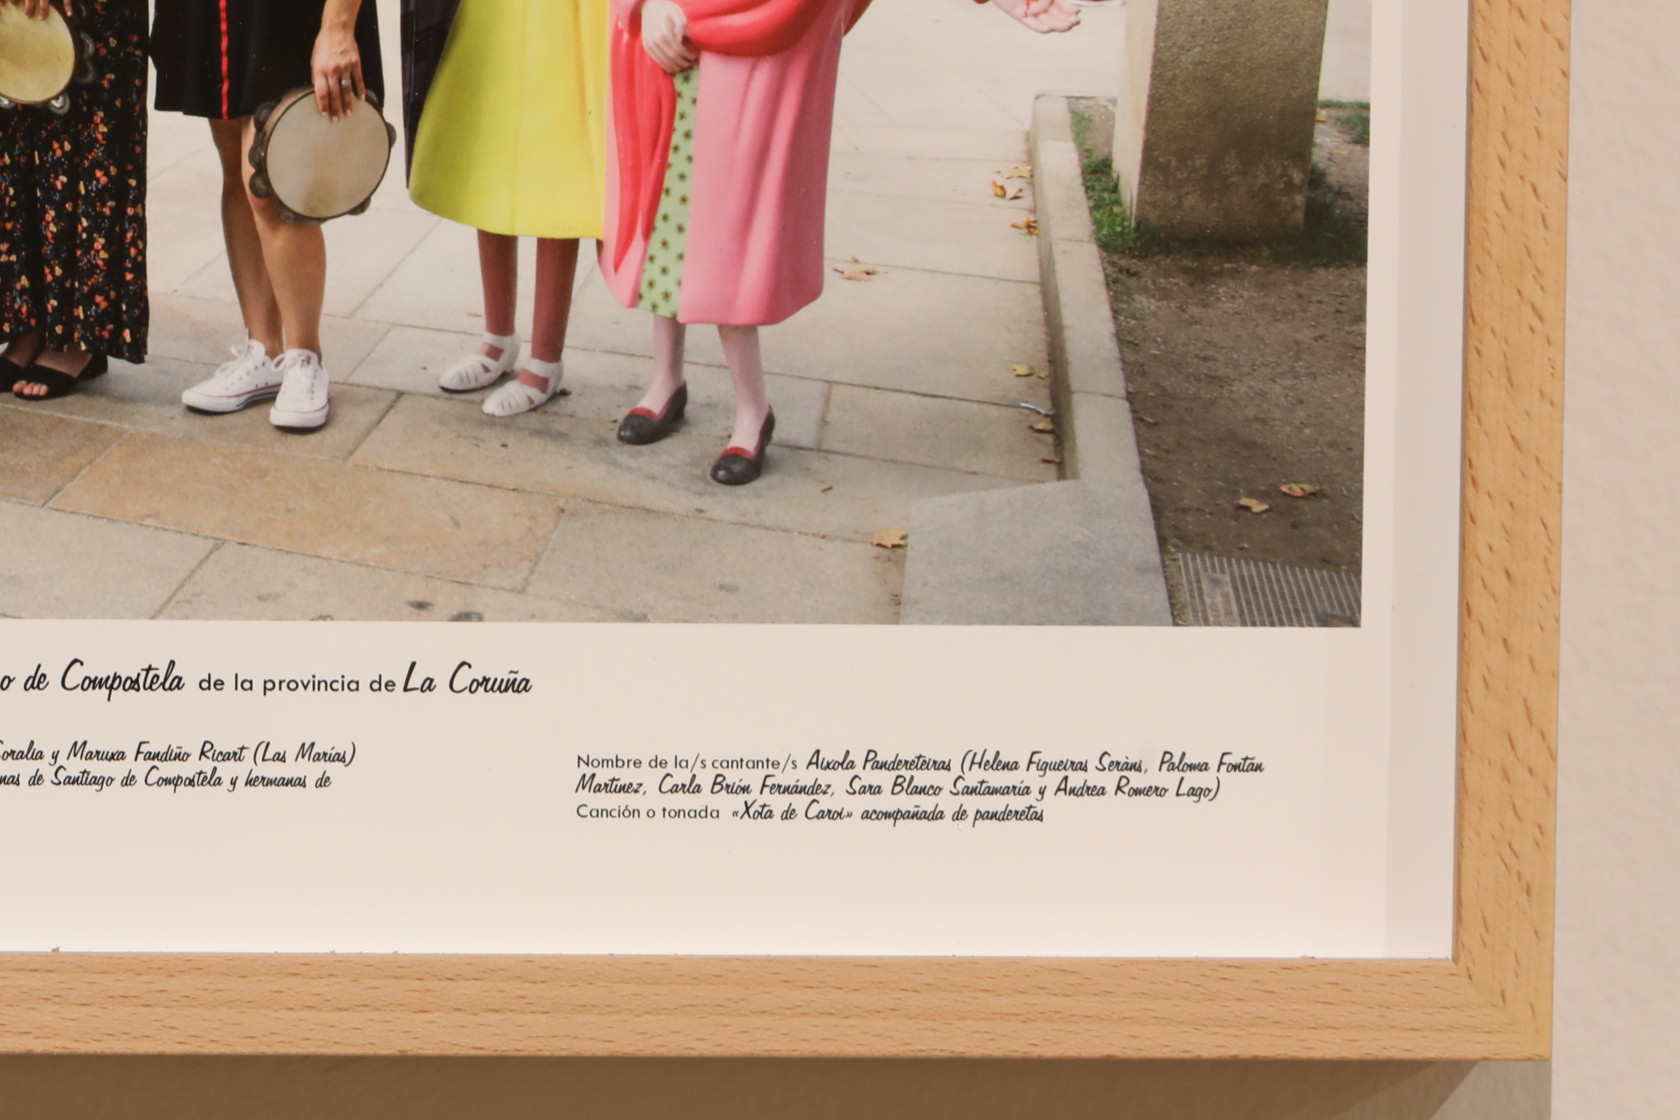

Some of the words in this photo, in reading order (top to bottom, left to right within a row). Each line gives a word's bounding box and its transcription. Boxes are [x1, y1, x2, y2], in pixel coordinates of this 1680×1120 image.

[23, 663, 49, 692] de
[61, 658, 185, 702] Compostela
[199, 673, 225, 691] de
[235, 673, 253, 691] la
[263, 674, 359, 696] provincia
[369, 674, 396, 692] de
[403, 661, 436, 693] La
[449, 661, 532, 694] Coruña
[49, 750, 60, 766] y
[67, 740, 127, 762] Maruxa
[134, 741, 192, 763] Fandiño
[199, 740, 249, 763] Ricart
[577, 754, 642, 768] Nombre
[648, 755, 668, 769] de
[1026, 751, 1088, 777] Figueiras
[1158, 751, 1210, 773] Paloma
[28, 768, 44, 787] de
[51, 765, 115, 792] Santiago
[120, 769, 137, 787] de
[144, 765, 223, 794] Compostela
[227, 776, 238, 792] y
[244, 769, 307, 788] hermanas
[315, 770, 332, 788] de
[658, 773, 703, 794] Carla
[846, 774, 883, 795] Sara
[891, 774, 944, 796] Blanco
[949, 775, 1032, 796] Santamaría
[1035, 785, 1047, 802] y
[1054, 775, 1107, 798] Andrea
[1114, 775, 1169, 797] Romero
[576, 804, 640, 818] Canción
[646, 809, 655, 818] o
[662, 805, 719, 819] tonada
[781, 802, 798, 821] de
[861, 803, 946, 827] acompañada
[952, 803, 968, 822] de
[972, 804, 1044, 828] panderetas
